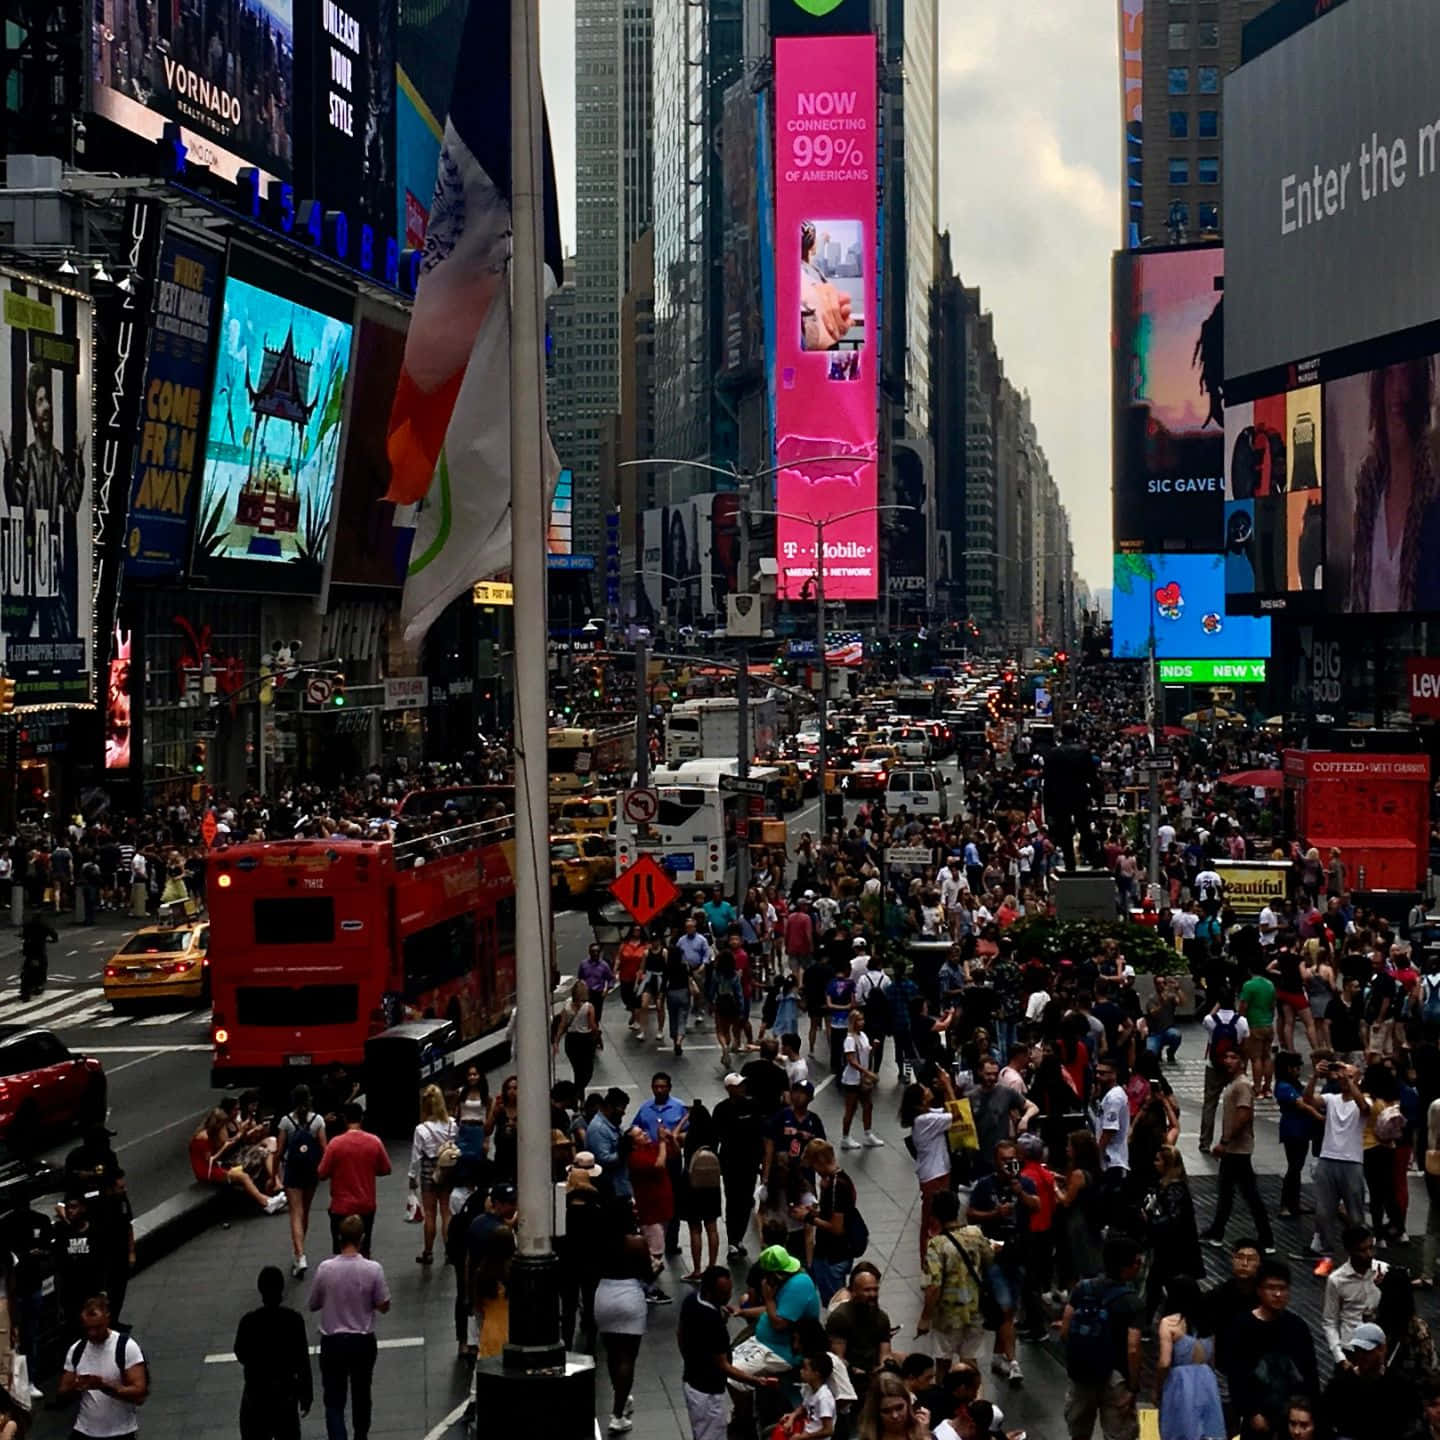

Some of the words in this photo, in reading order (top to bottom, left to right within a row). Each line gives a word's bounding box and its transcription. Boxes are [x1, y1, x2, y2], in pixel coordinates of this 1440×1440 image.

[329, 45, 353, 94] YOUR
[163, 54, 241, 127] VORNADO
[328, 90, 354, 139] STYLE
[797, 91, 857, 116] NOW
[786, 118, 867, 132] CONNECTING
[792, 134, 864, 168] 99%
[785, 171, 800, 182] OF
[802, 169, 869, 182] AMERICANS
[1280, 163, 1351, 236] Enter
[1359, 132, 1407, 202] the
[147, 376, 202, 429] COME
[132, 463, 192, 516] AWAY
[1147, 480, 1172, 493] SIC
[1174, 477, 1217, 492] GAVE
[830, 567, 872, 577] NETWORK
[1213, 665, 1248, 678] NEW
[1313, 641, 1341, 679] BIG
[1313, 679, 1342, 703] BOLD
[1312, 761, 1365, 773] COFFEED
[1222, 878, 1285, 896] eautiful
